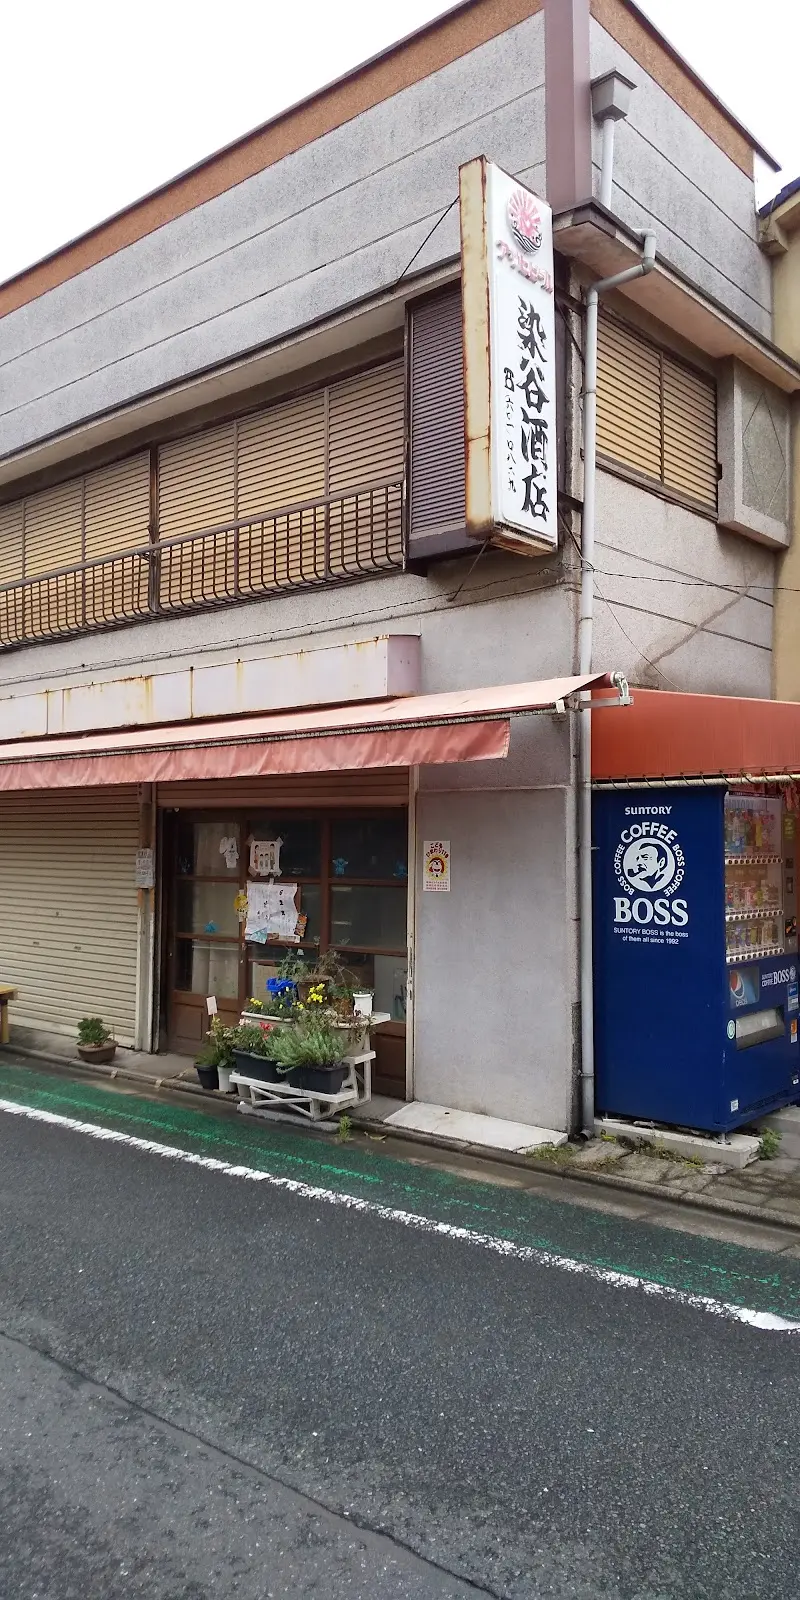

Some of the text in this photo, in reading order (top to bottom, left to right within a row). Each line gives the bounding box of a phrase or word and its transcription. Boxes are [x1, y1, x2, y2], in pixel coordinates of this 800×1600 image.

[517, 295, 550, 522] 染谷酒店
[620, 821, 678, 845] COFFEE
[613, 843, 635, 896] BOSS COFFEE
[663, 843, 686, 897] BOSS COFFEE
[613, 897, 689, 927] BOSS
[613, 927, 641, 935] SUNTORY
[773, 968, 790, 985] BOSS
